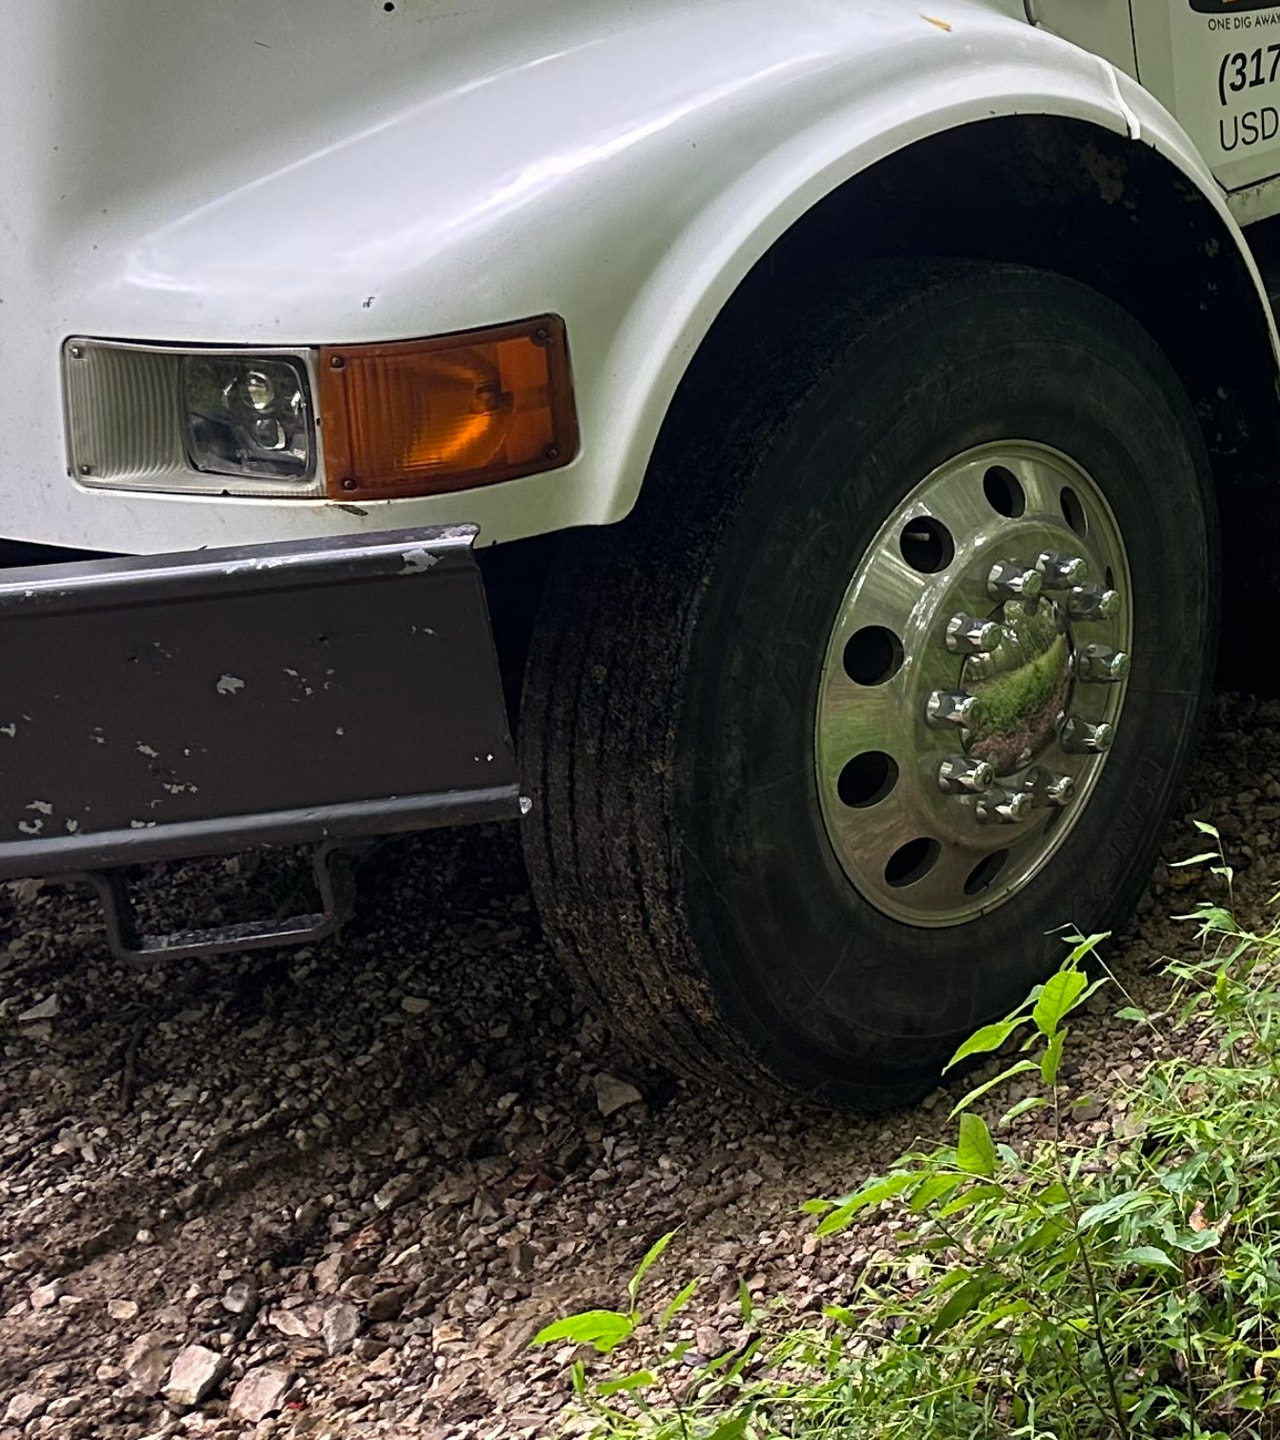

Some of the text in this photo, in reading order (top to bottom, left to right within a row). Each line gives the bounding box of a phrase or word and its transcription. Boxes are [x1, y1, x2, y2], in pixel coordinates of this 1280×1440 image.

[1208, 17, 1231, 31] ONE
[1234, 14, 1252, 30] DIG
[1255, 11, 1280, 28] AWAY
